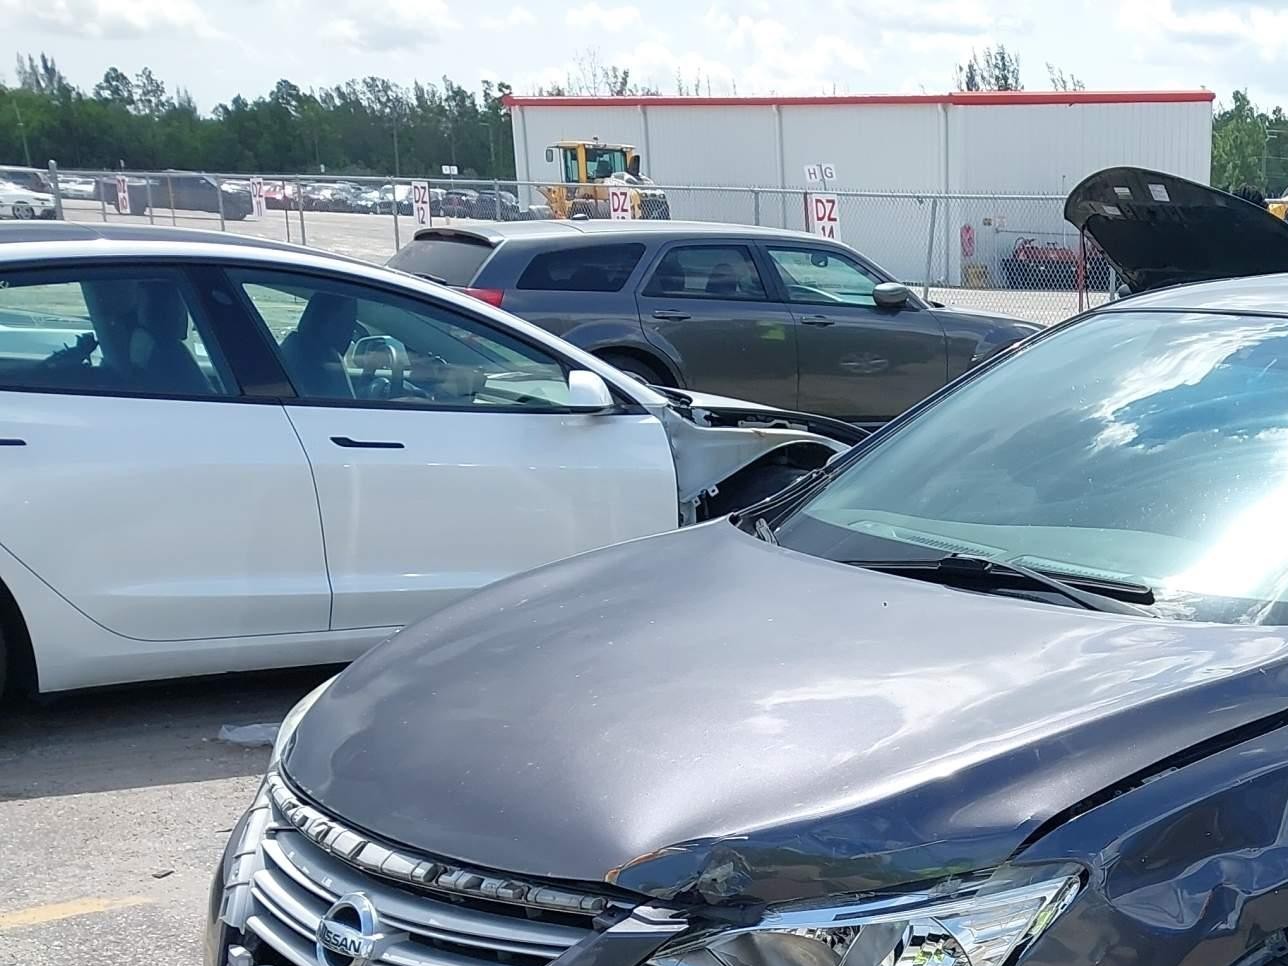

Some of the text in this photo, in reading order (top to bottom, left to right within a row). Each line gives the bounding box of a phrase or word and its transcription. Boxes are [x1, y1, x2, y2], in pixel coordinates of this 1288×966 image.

[807, 166, 834, 179] H G
[251, 182, 263, 198] DZ
[413, 185, 428, 205] DZ
[611, 191, 629, 213] DZ
[815, 198, 837, 222] DZ
[417, 206, 426, 225] 12
[320, 920, 362, 954] NISSAN
